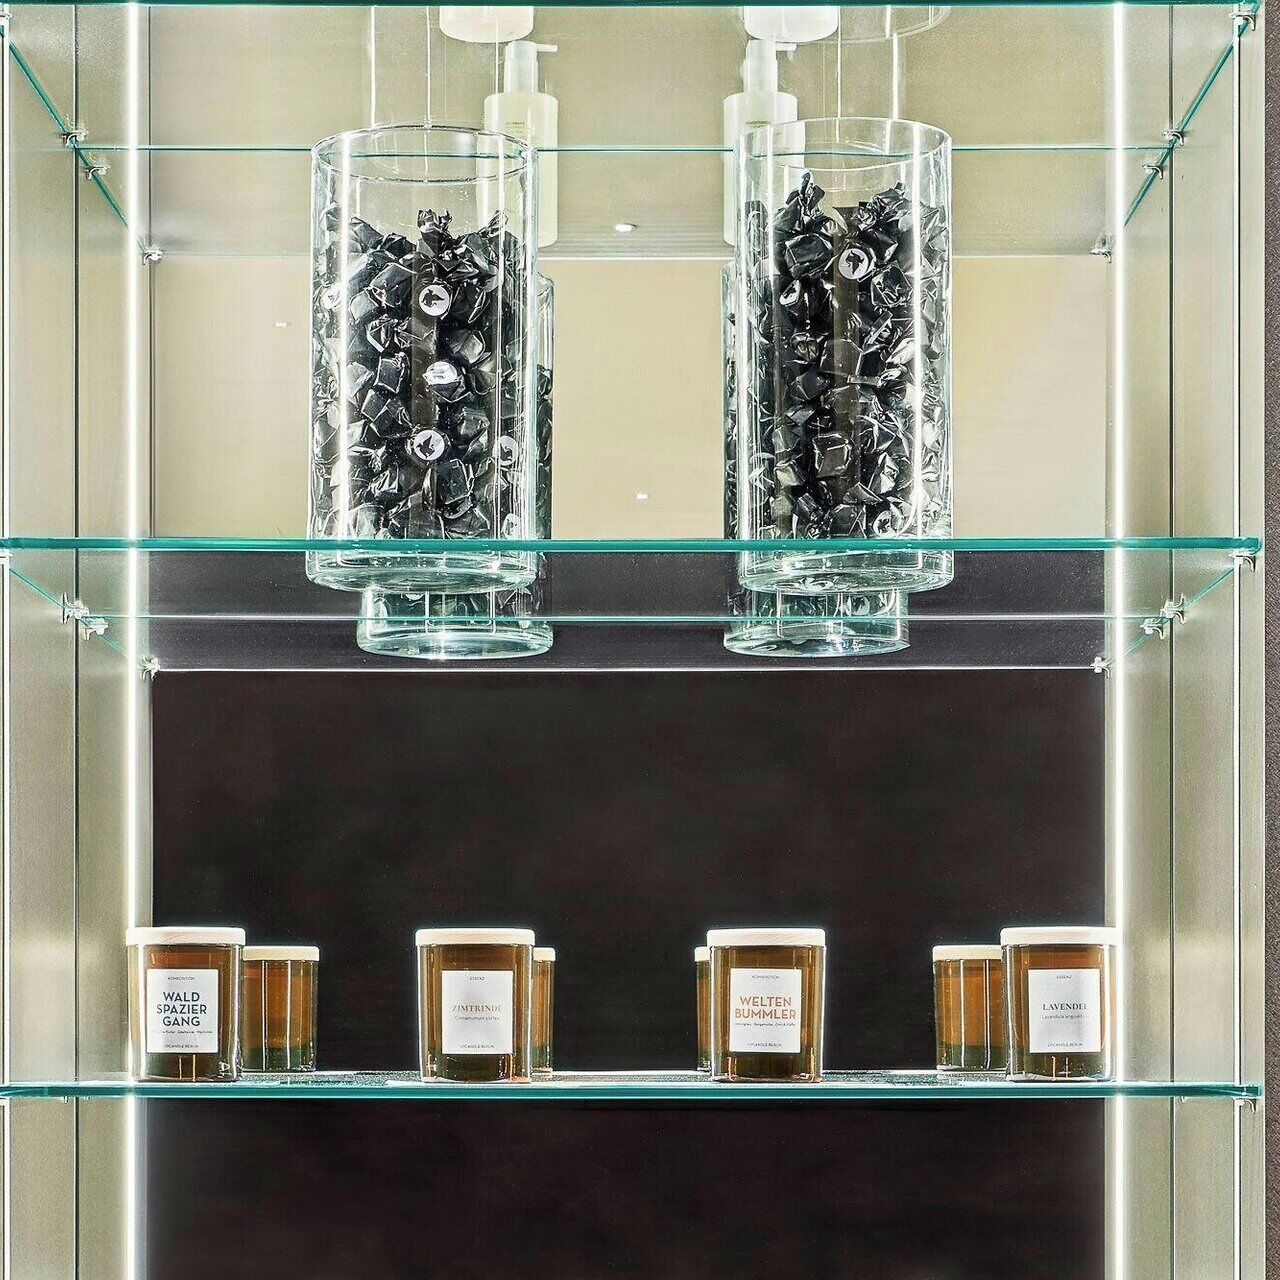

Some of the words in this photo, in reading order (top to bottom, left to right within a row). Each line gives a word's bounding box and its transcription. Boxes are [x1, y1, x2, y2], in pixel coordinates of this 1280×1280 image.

[163, 991, 200, 1002] WALD
[740, 996, 792, 1007] WELTEN
[156, 1004, 207, 1015] SPAZIER
[735, 1008, 797, 1019] BUMMLER
[162, 1016, 200, 1027] GANG
